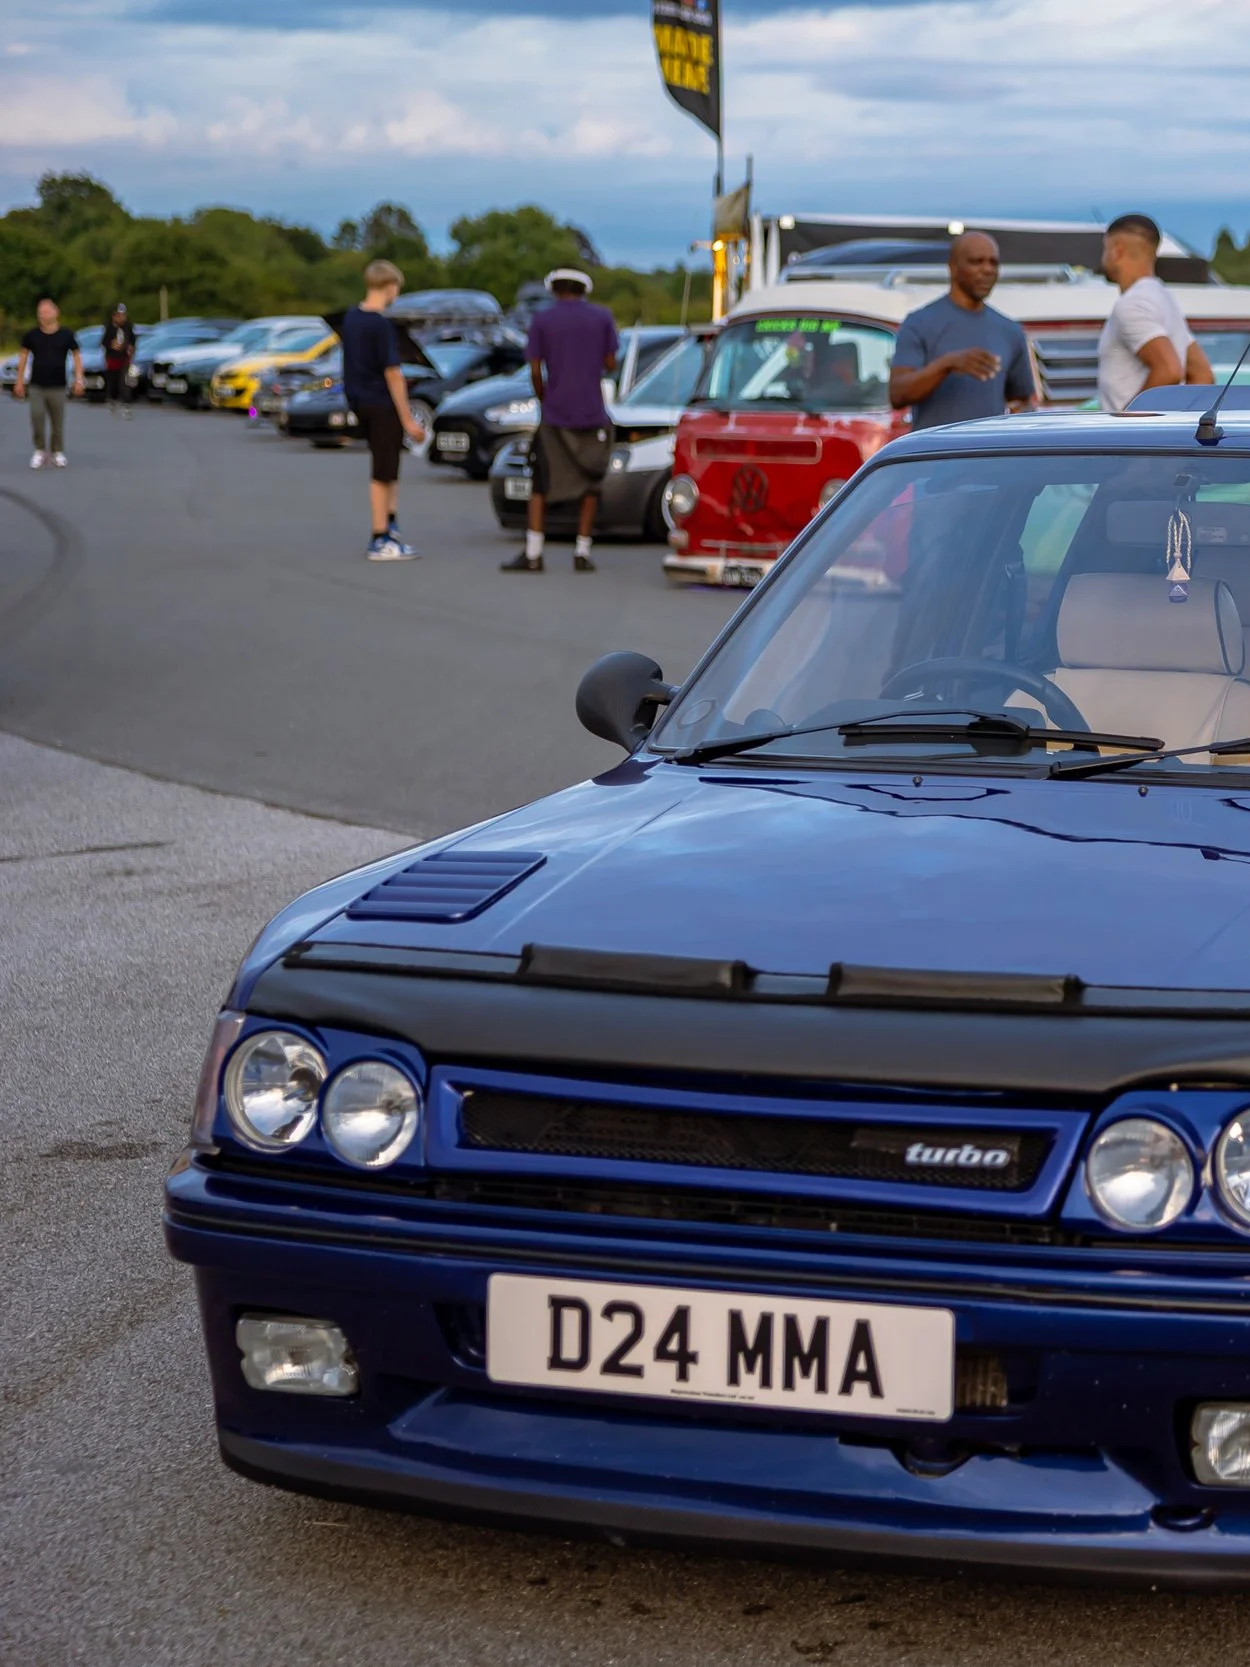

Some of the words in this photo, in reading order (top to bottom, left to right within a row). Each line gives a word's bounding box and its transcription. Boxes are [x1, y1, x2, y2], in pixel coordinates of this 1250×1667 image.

[905, 1142, 1010, 1169] turbo
[547, 1293, 698, 1383] D24
[726, 1308, 885, 1399] MMA
